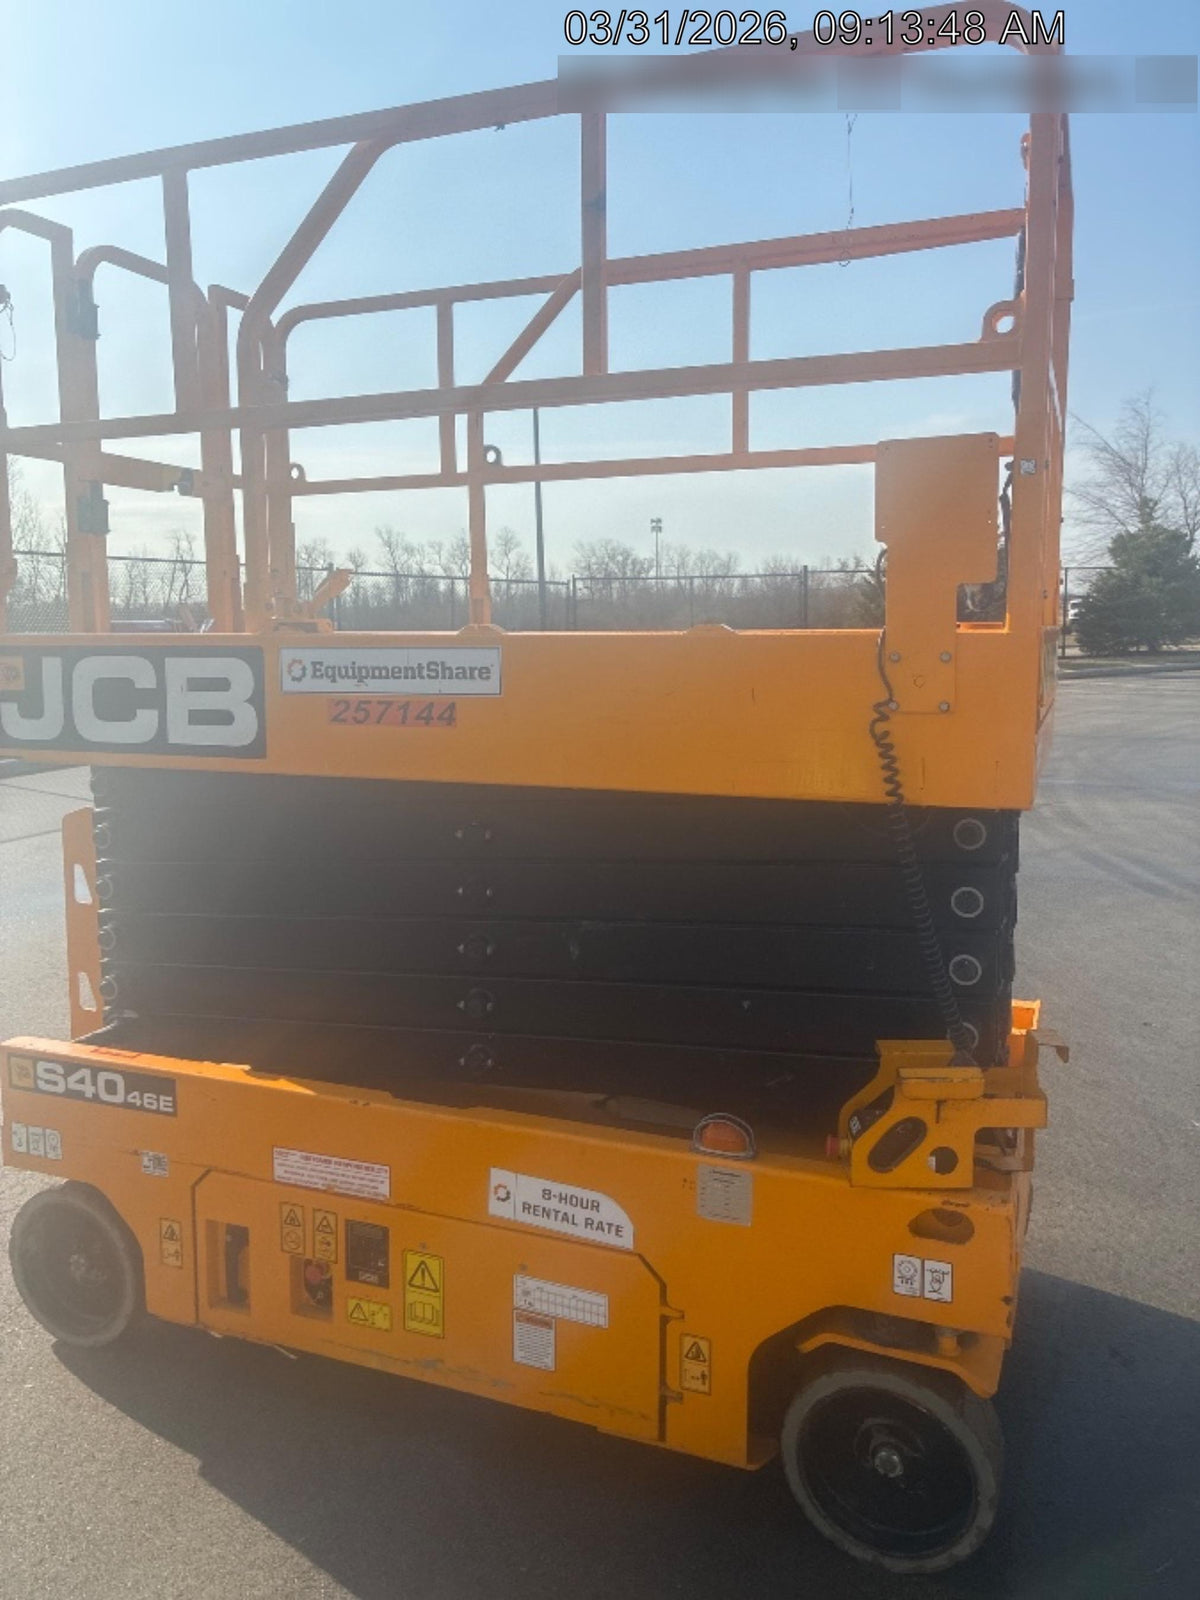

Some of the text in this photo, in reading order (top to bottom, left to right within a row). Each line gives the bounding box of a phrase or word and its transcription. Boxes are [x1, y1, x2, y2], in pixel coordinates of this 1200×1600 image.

[310, 660, 491, 683] EquipmentShare
[0, 655, 258, 746] JCB
[330, 700, 457, 726] 257144
[542, 1188, 600, 1213] 8-HOUR
[522, 1201, 624, 1238] RENTAL RATE
